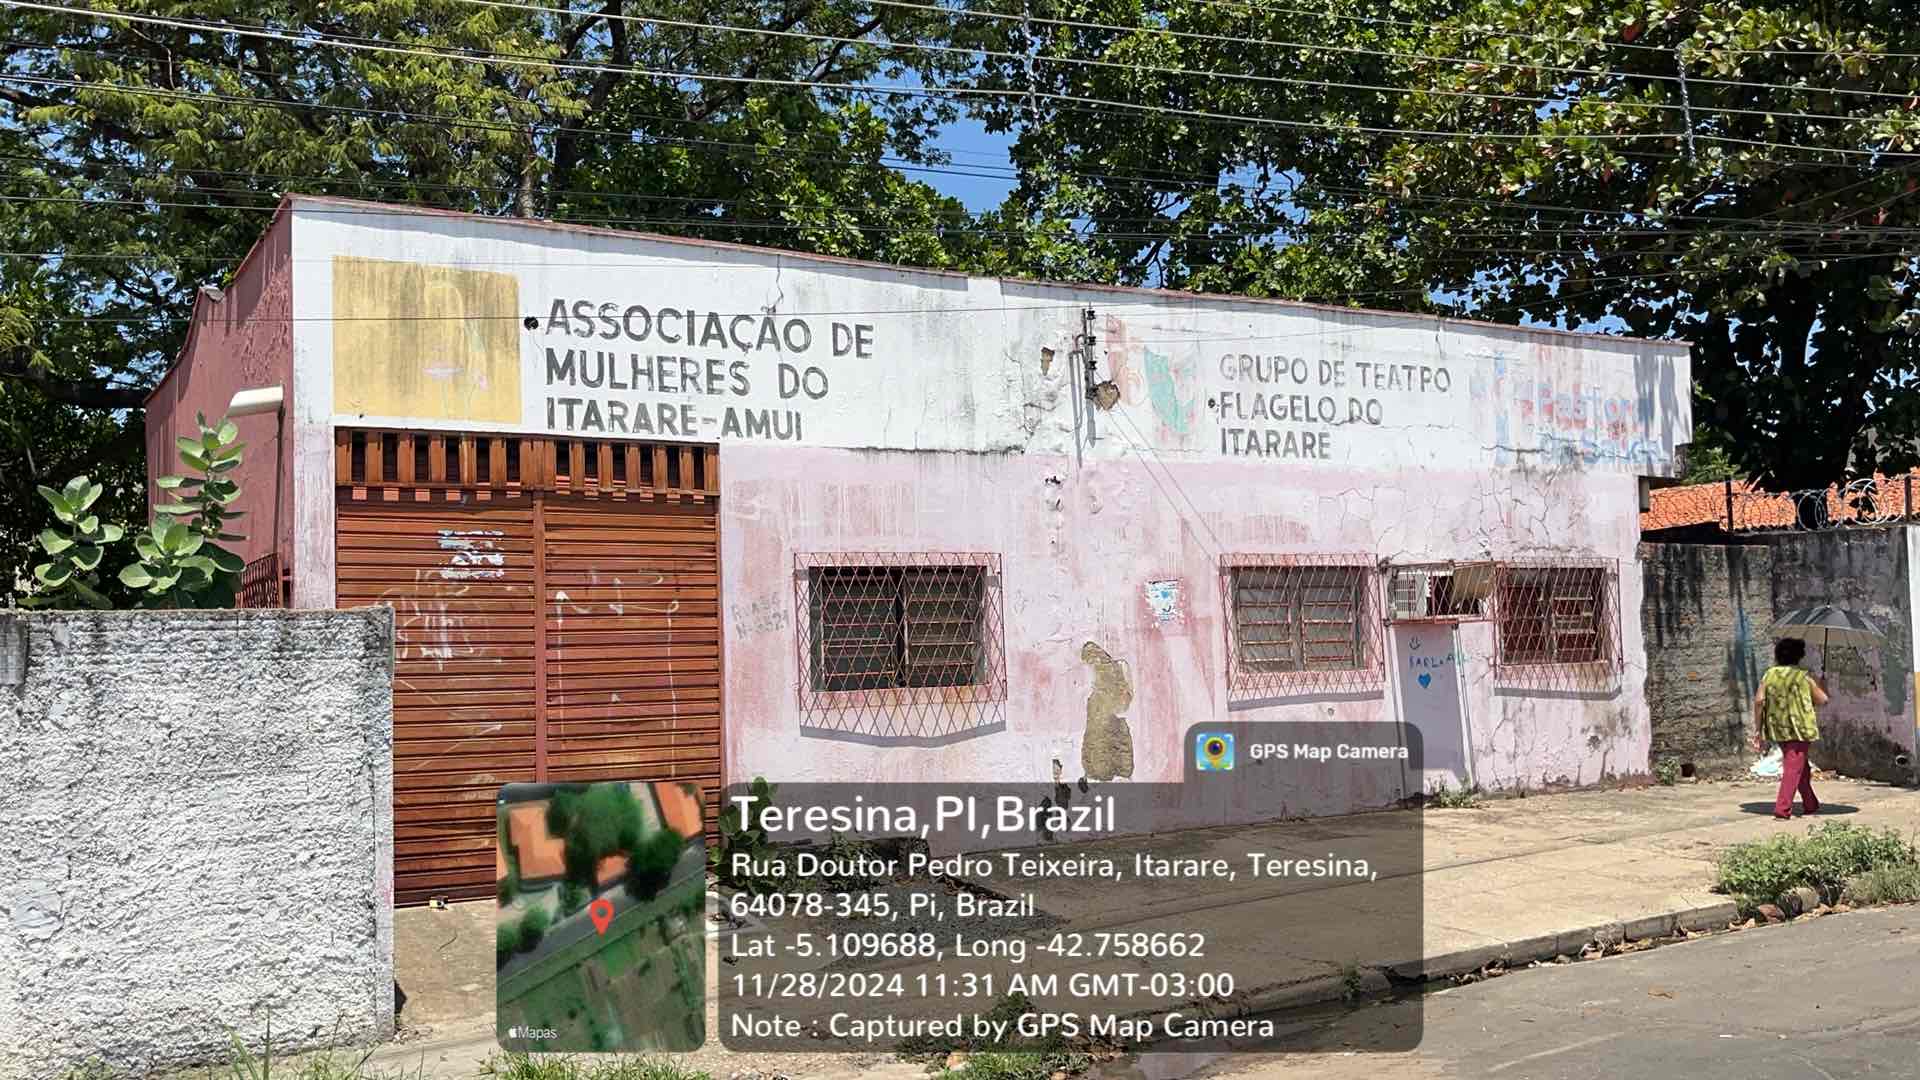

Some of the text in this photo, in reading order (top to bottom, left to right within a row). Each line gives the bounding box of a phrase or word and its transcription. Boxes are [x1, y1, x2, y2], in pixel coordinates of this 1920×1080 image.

[545, 298, 874, 359] ASSOCIAÇÃO DE
[545, 347, 829, 400] MULHERES DO
[1219, 353, 1308, 385] GRUPO
[1318, 359, 1345, 387] DE
[1220, 391, 1383, 425] FLAGELO DO
[1220, 427, 1332, 459] ITARARE
